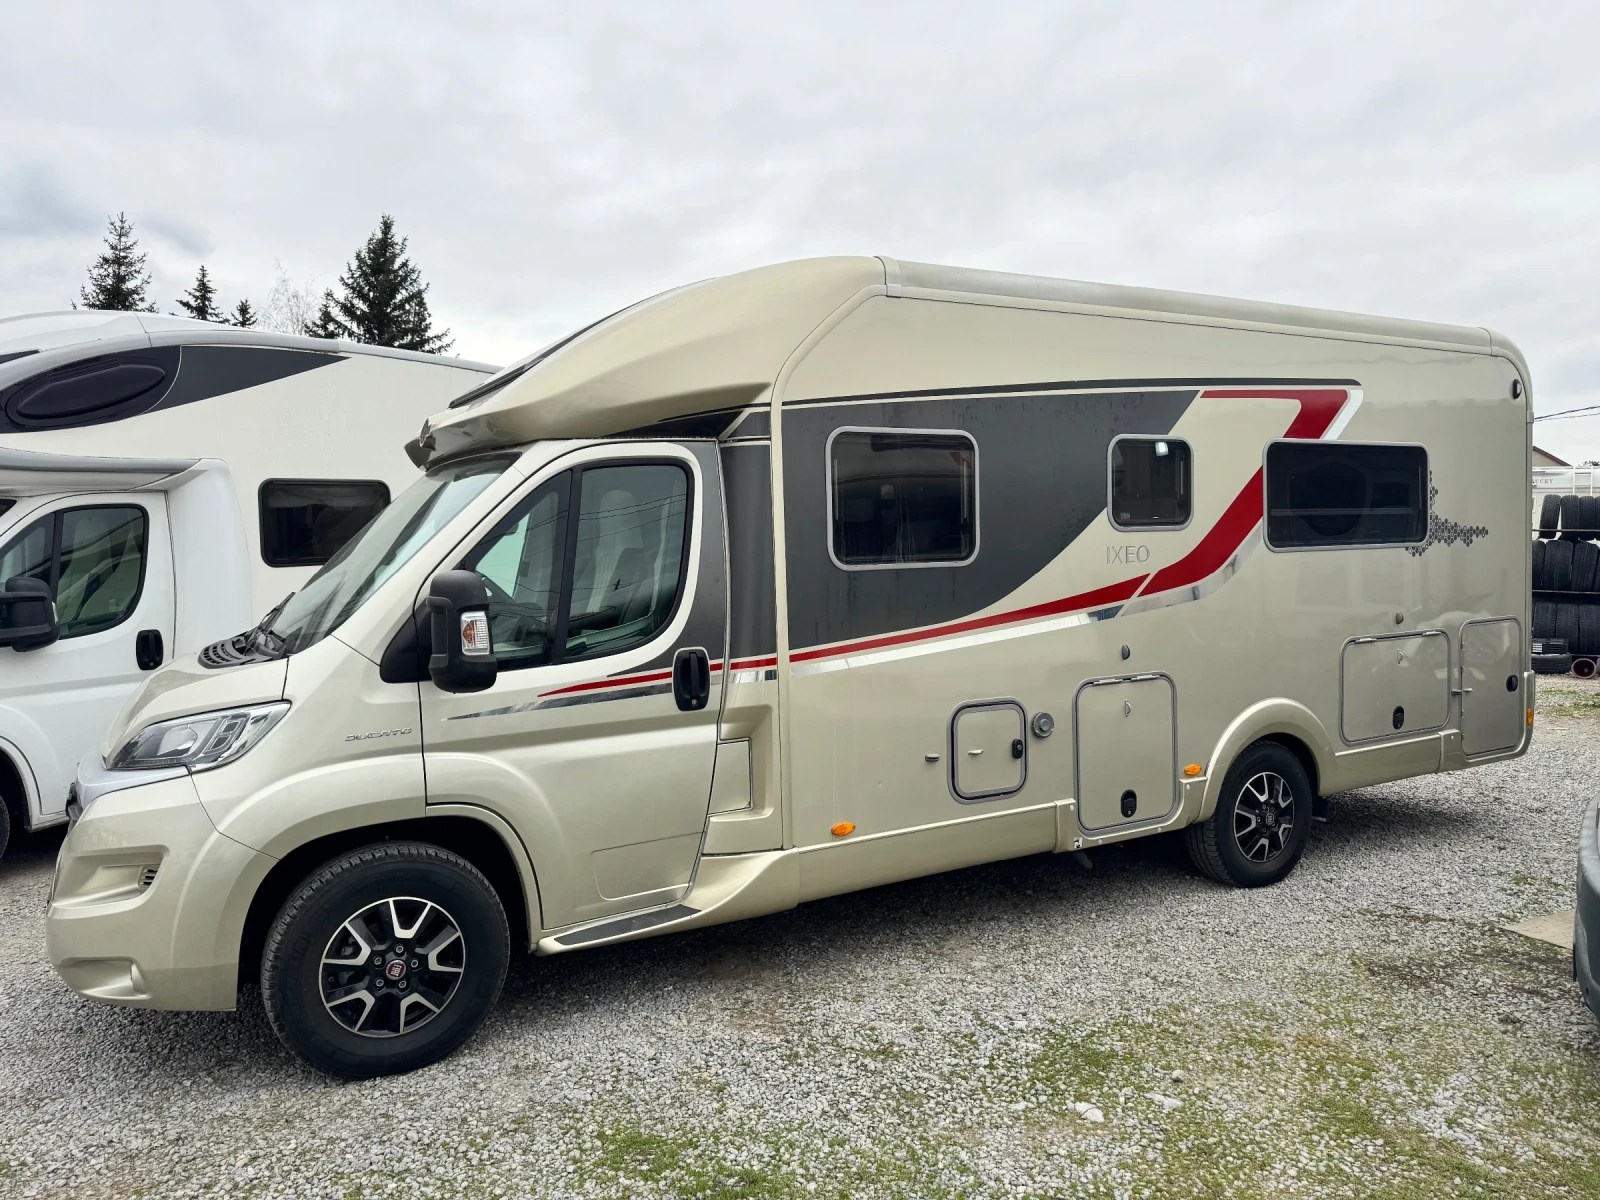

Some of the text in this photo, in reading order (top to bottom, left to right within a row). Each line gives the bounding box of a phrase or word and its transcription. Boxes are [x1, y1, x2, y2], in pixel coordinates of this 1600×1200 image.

[1107, 545, 1150, 565] IXEO
[345, 727, 412, 742] DUCATO
[390, 964, 402, 977] FIAT
